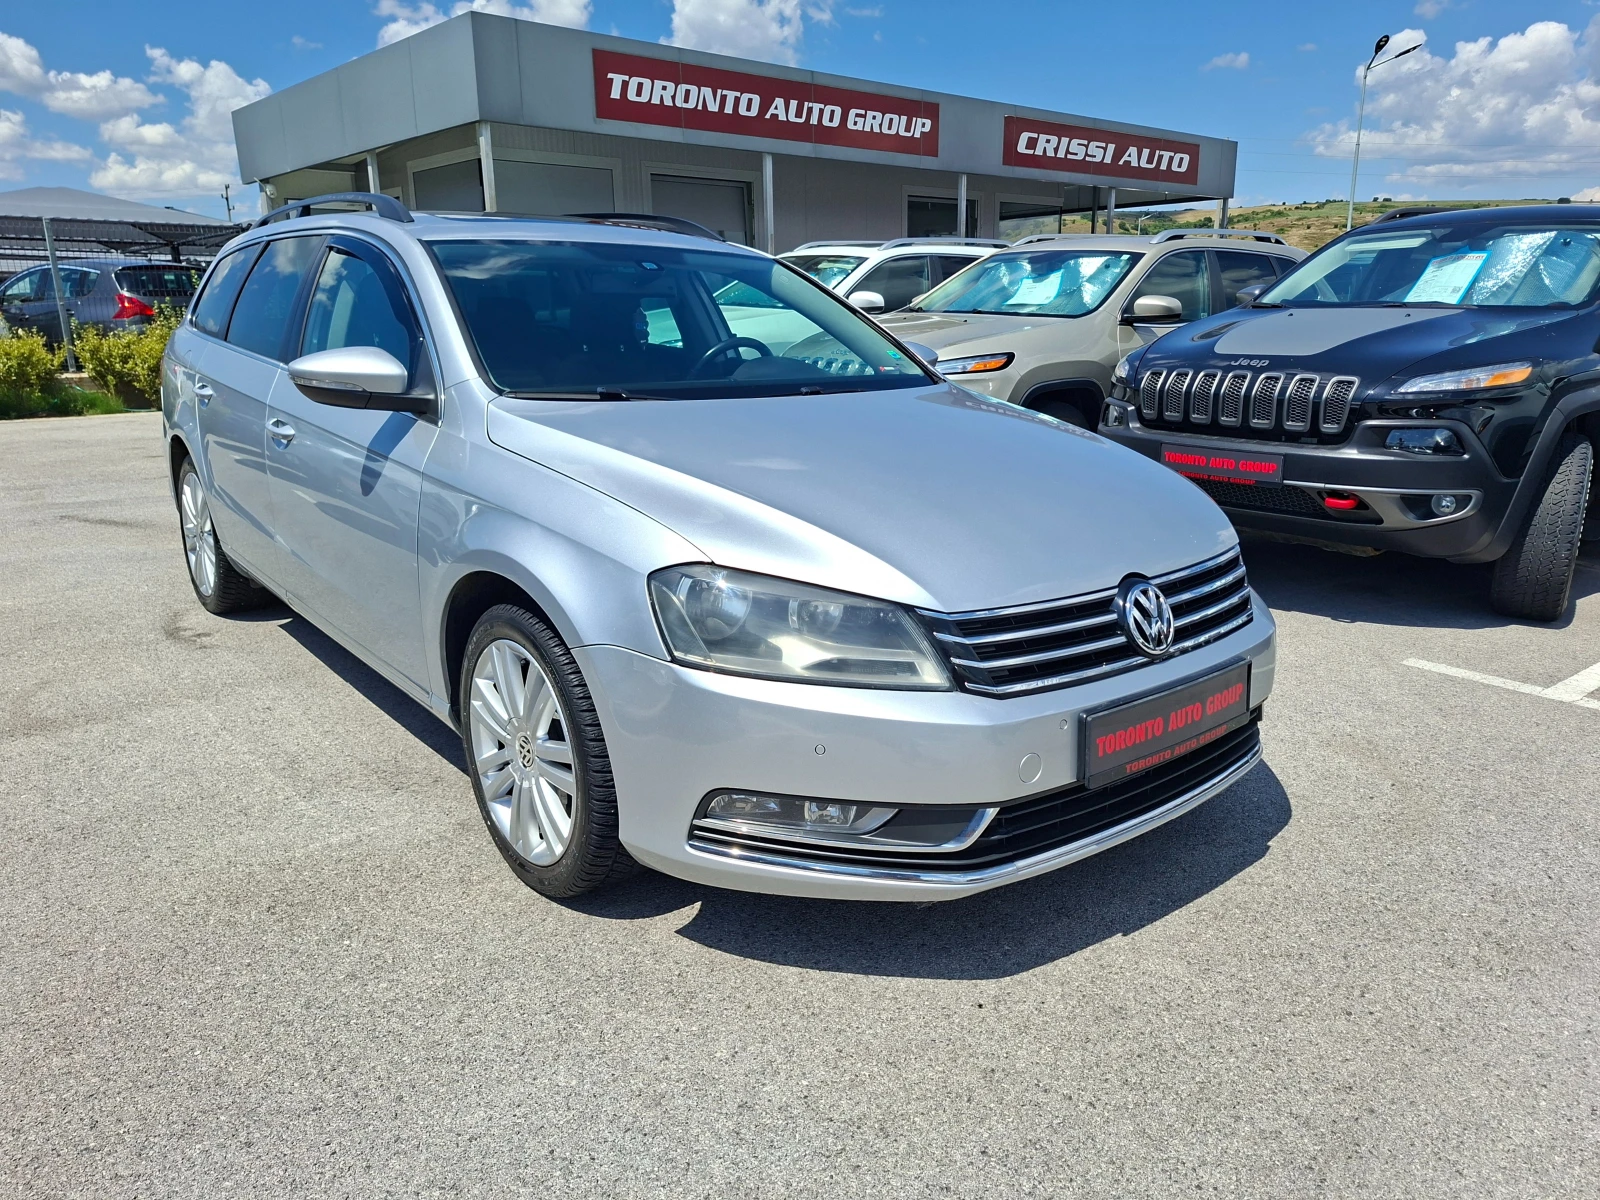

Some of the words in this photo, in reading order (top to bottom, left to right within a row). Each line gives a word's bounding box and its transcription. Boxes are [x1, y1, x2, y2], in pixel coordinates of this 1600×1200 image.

[606, 72, 761, 118] TORONTO
[764, 97, 842, 128] AUTO
[846, 108, 932, 139] GROUP
[1016, 131, 1116, 164] CRISSI
[1117, 146, 1190, 173] AUTO
[1230, 357, 1269, 367] Jeep
[1164, 452, 1206, 466] TORONTO
[1209, 458, 1235, 469] AUTO
[1238, 461, 1277, 473] GROUP
[1210, 474, 1229, 482] AUTO
[1096, 717, 1163, 757] TORONTO
[1168, 703, 1202, 731] AUTO
[1206, 683, 1243, 715] GROUP
[1126, 750, 1171, 773] TORONTO
[1174, 740, 1196, 755] AUTO
[1200, 725, 1227, 746] GROUP
